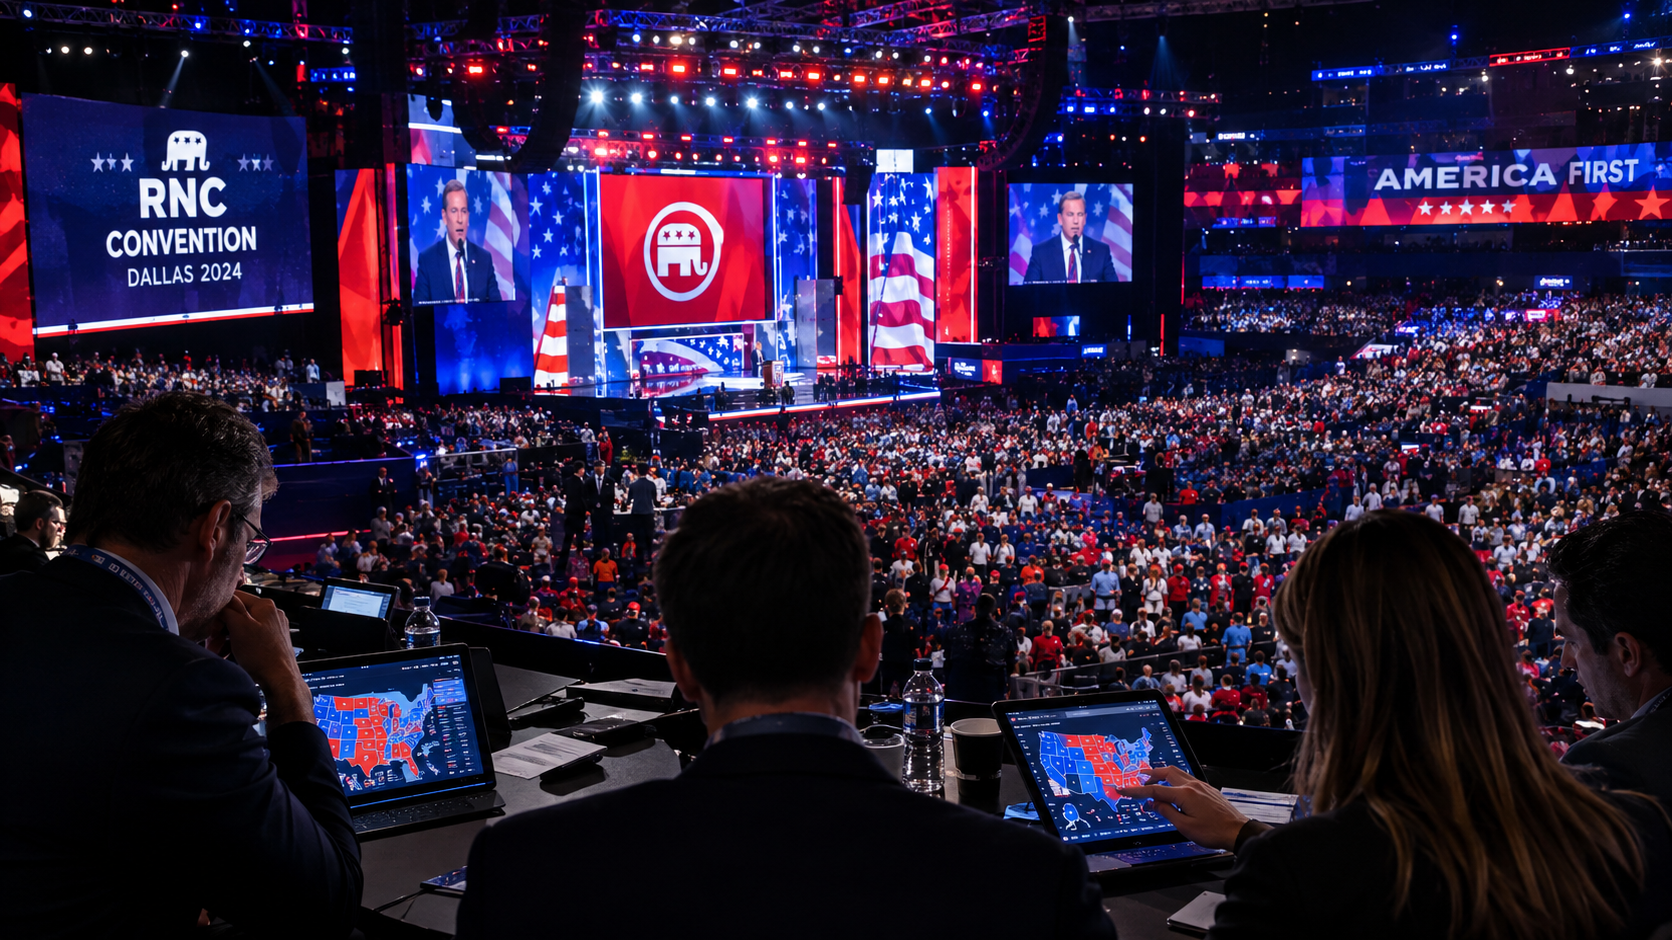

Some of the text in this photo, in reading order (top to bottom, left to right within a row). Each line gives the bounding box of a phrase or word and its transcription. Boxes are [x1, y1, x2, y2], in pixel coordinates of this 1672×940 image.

[1374, 159, 1639, 190] AMERICA FIRST
[139, 177, 228, 219] RNC
[106, 226, 257, 258] CONVENTION
[127, 262, 242, 287] DALLAS 2024
